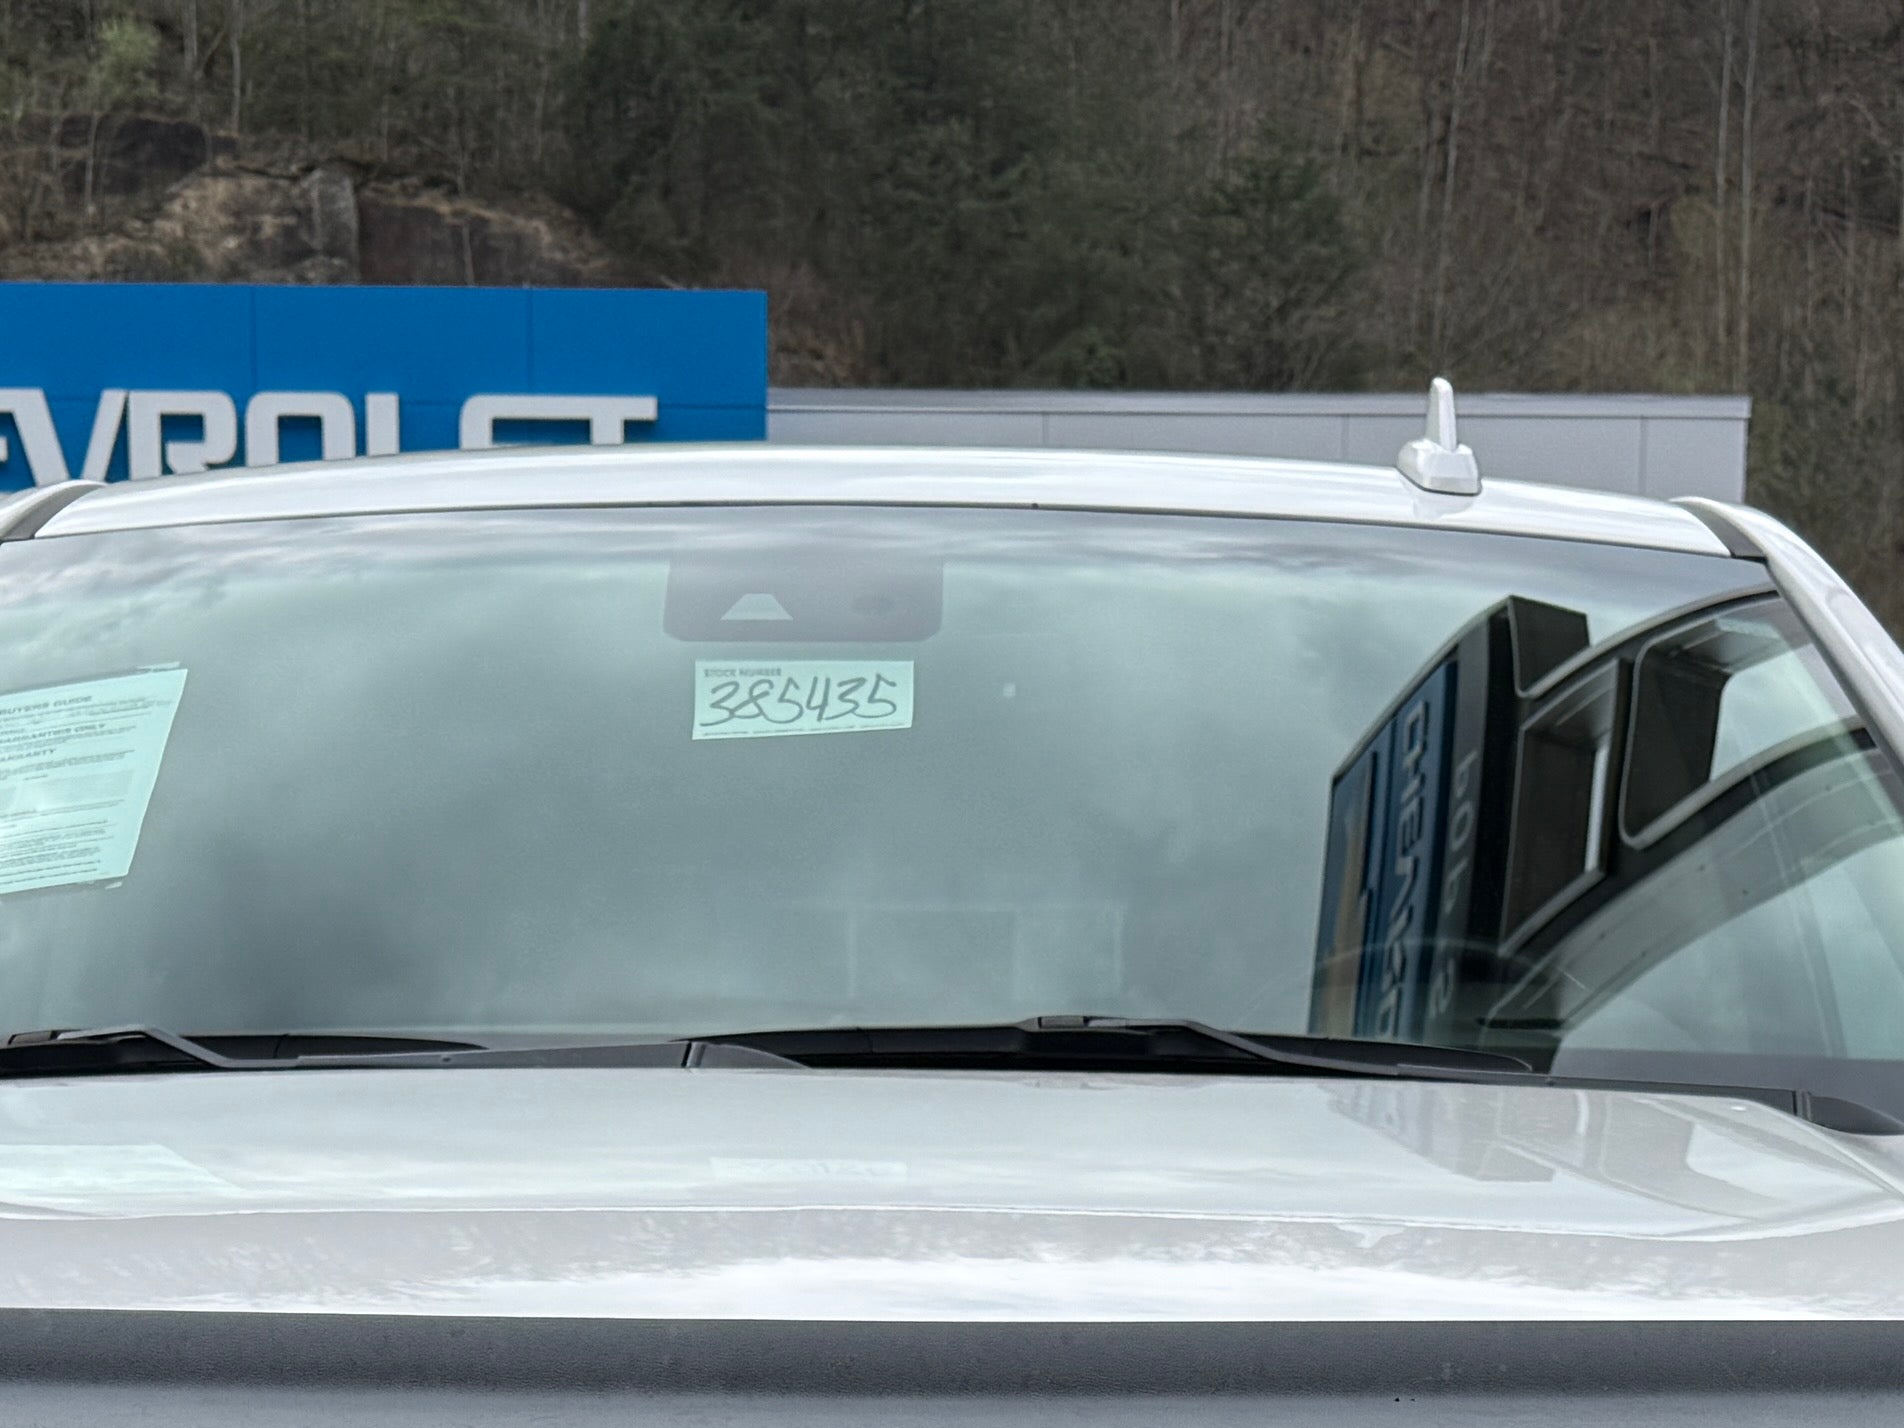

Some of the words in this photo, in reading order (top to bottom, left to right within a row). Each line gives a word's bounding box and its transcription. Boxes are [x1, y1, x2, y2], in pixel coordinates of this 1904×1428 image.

[703, 668, 737, 678] STOCK
[739, 667, 783, 677] NUMBER
[699, 673, 897, 727] 385435
